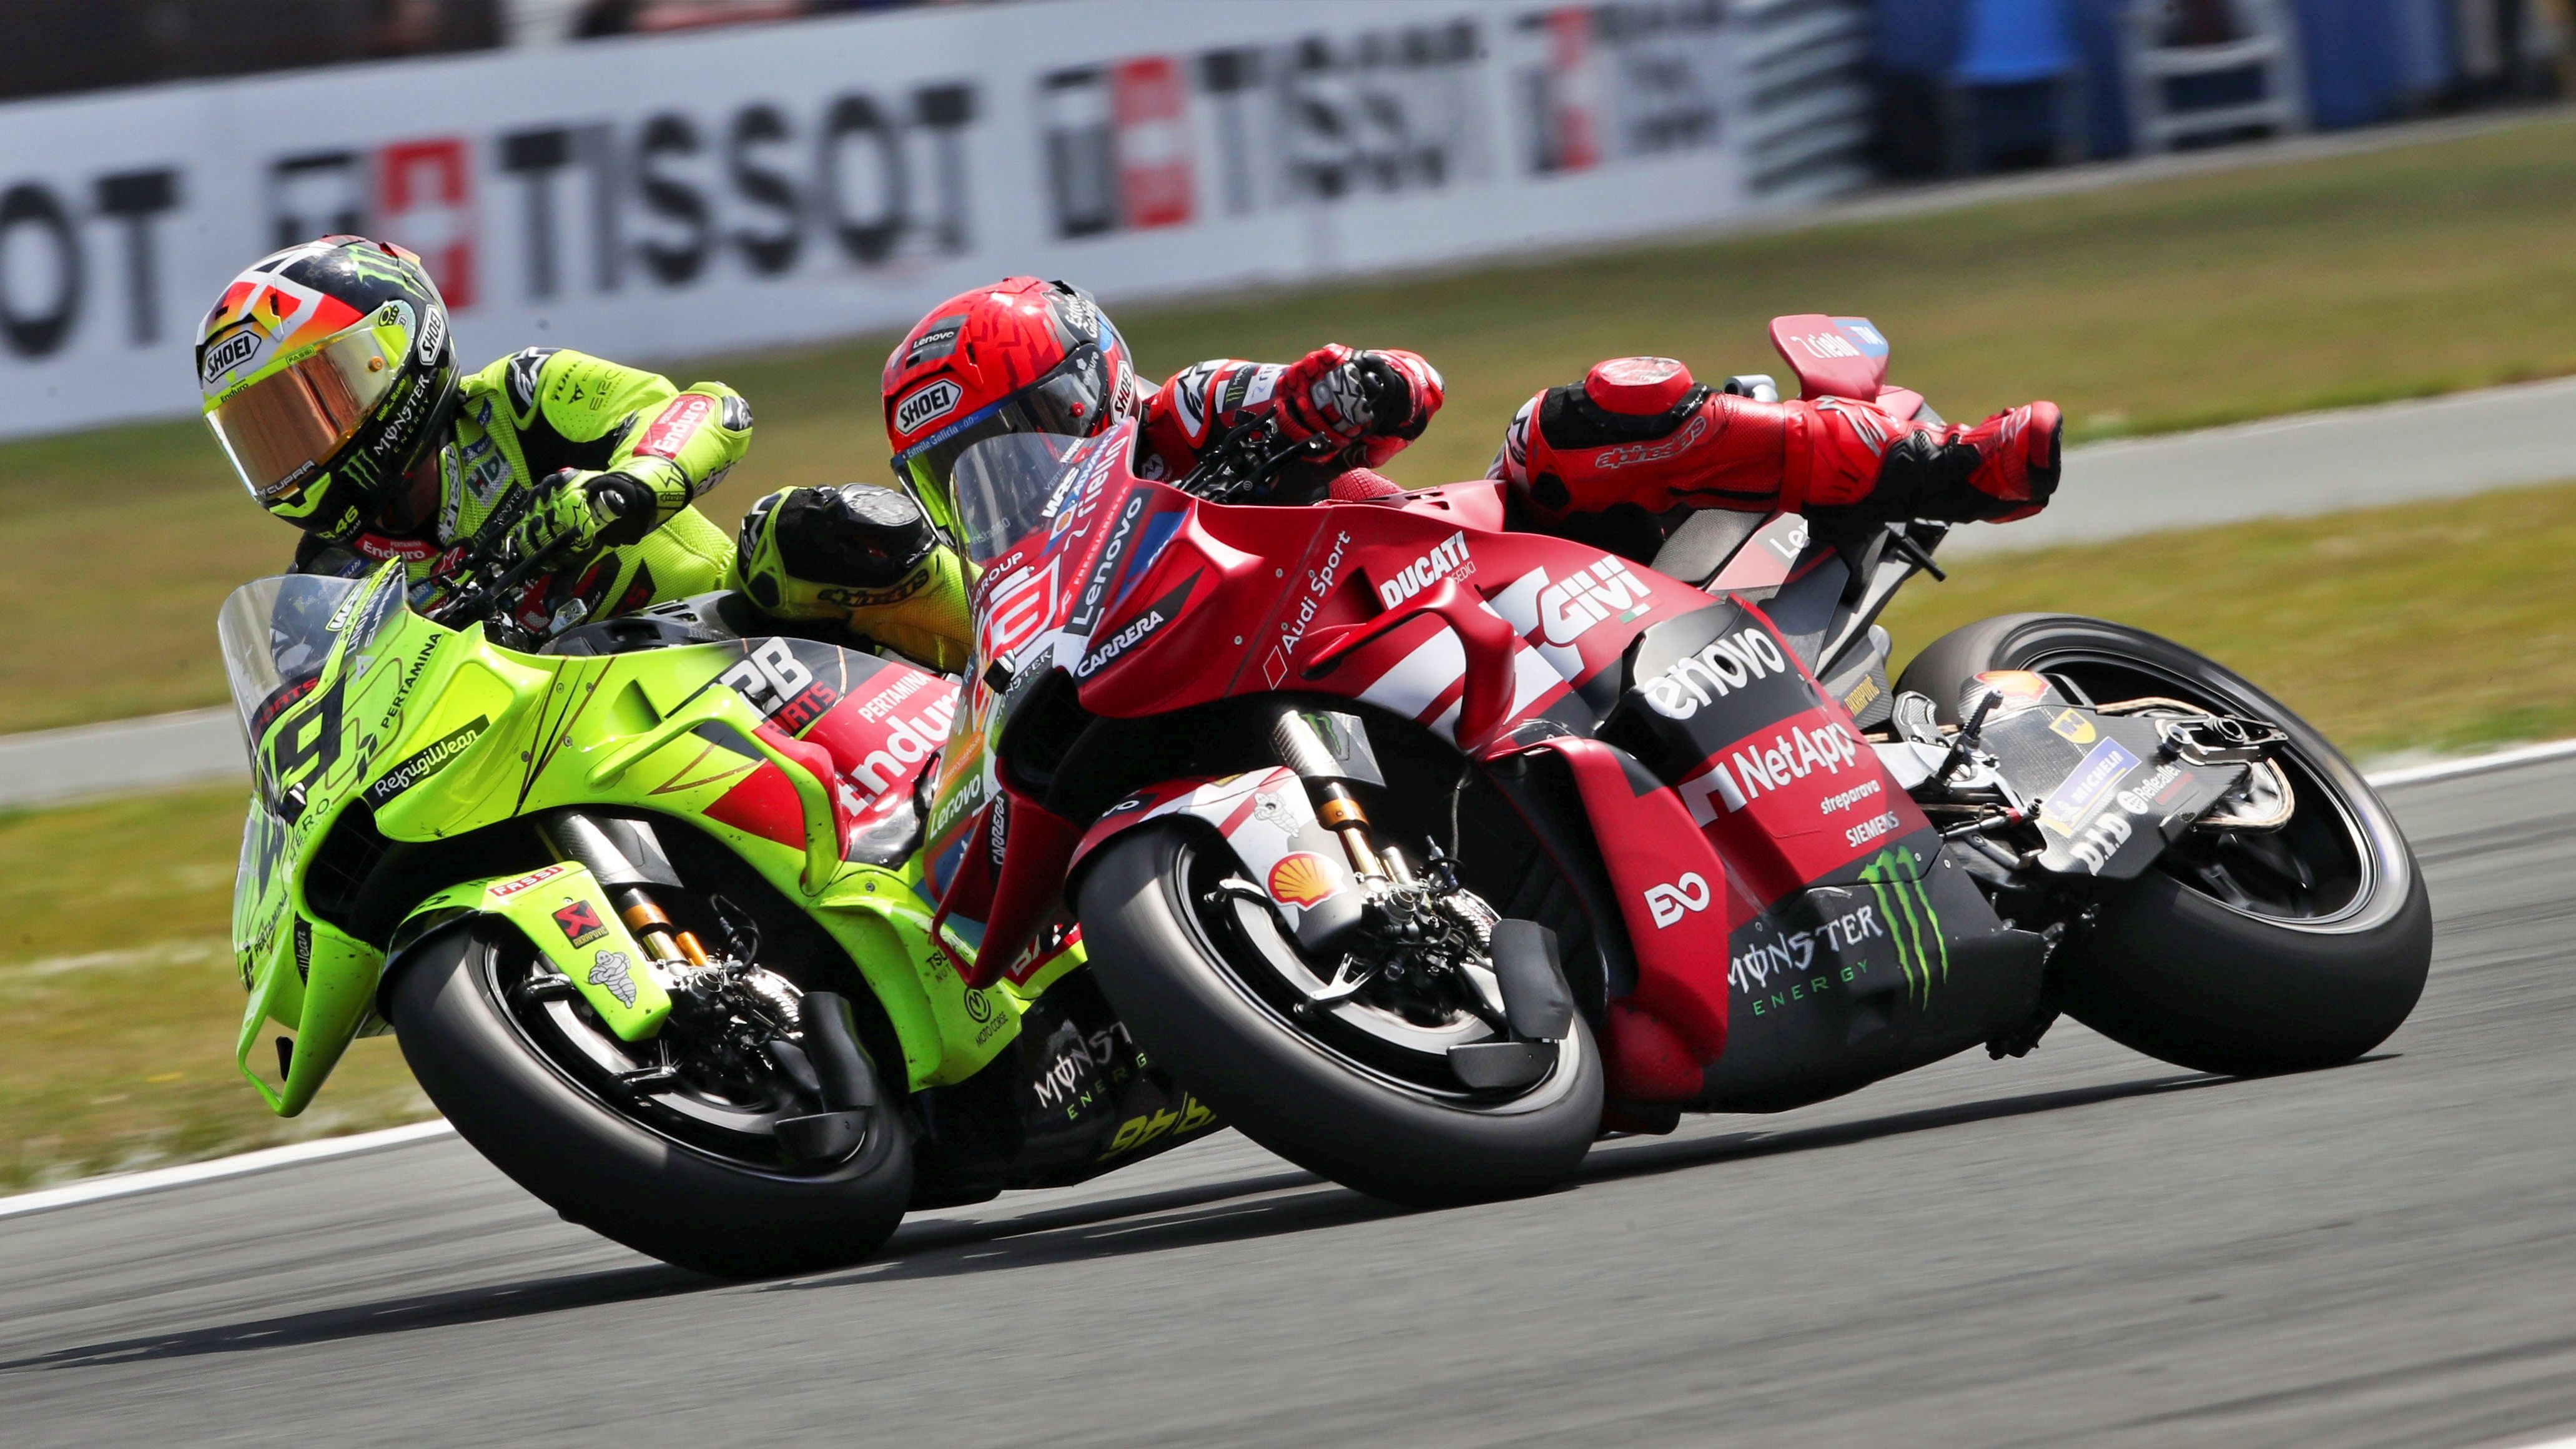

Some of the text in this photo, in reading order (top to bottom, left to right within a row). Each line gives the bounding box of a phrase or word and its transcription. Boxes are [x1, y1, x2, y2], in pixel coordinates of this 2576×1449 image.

[495, 79, 982, 305] TISSOT
[207, 336, 252, 377] SHOEI
[289, 348, 313, 362] FASSI
[422, 310, 442, 359] SHOEI
[912, 331, 955, 349] Lenovo
[220, 382, 249, 403] Enduro
[899, 385, 950, 428] SHOEI
[1114, 368, 1132, 418] SHOEI
[653, 400, 707, 453] Enduro
[906, 440, 931, 458] Estrella
[930, 425, 959, 445] Galicia
[267, 459, 315, 495] CUPRA
[1040, 467, 1081, 518] WRS
[1077, 435, 1129, 518] riello
[362, 540, 425, 560] Enduro
[1072, 497, 1142, 625] Lenovo
[1379, 530, 1471, 610] DUCATI
[1281, 530, 1352, 656] Audi Sport
[1543, 553, 1654, 645] GIVI
[1077, 610, 1165, 678] CARRERA
[1644, 627, 1786, 720] enovo
[380, 631, 442, 729] PERTAMINA
[857, 668, 932, 723] PERTAMINA
[374, 728, 482, 798] RefrigiWear
[1732, 721, 1857, 799] NetApp
[929, 773, 981, 840] Lenovo
[1820, 778, 1882, 814] streparava
[992, 794, 1005, 866] CARRERA
[1845, 810, 1901, 848] SIEMENS
[493, 867, 560, 896] FASSI
[254, 890, 289, 957] PERTAMINA
[1727, 904, 1884, 994] MONSTER
[1752, 958, 1870, 1017] ENERGY
[1033, 1021, 1133, 1109] MONST
[1066, 1052, 1147, 1120] ENERG
